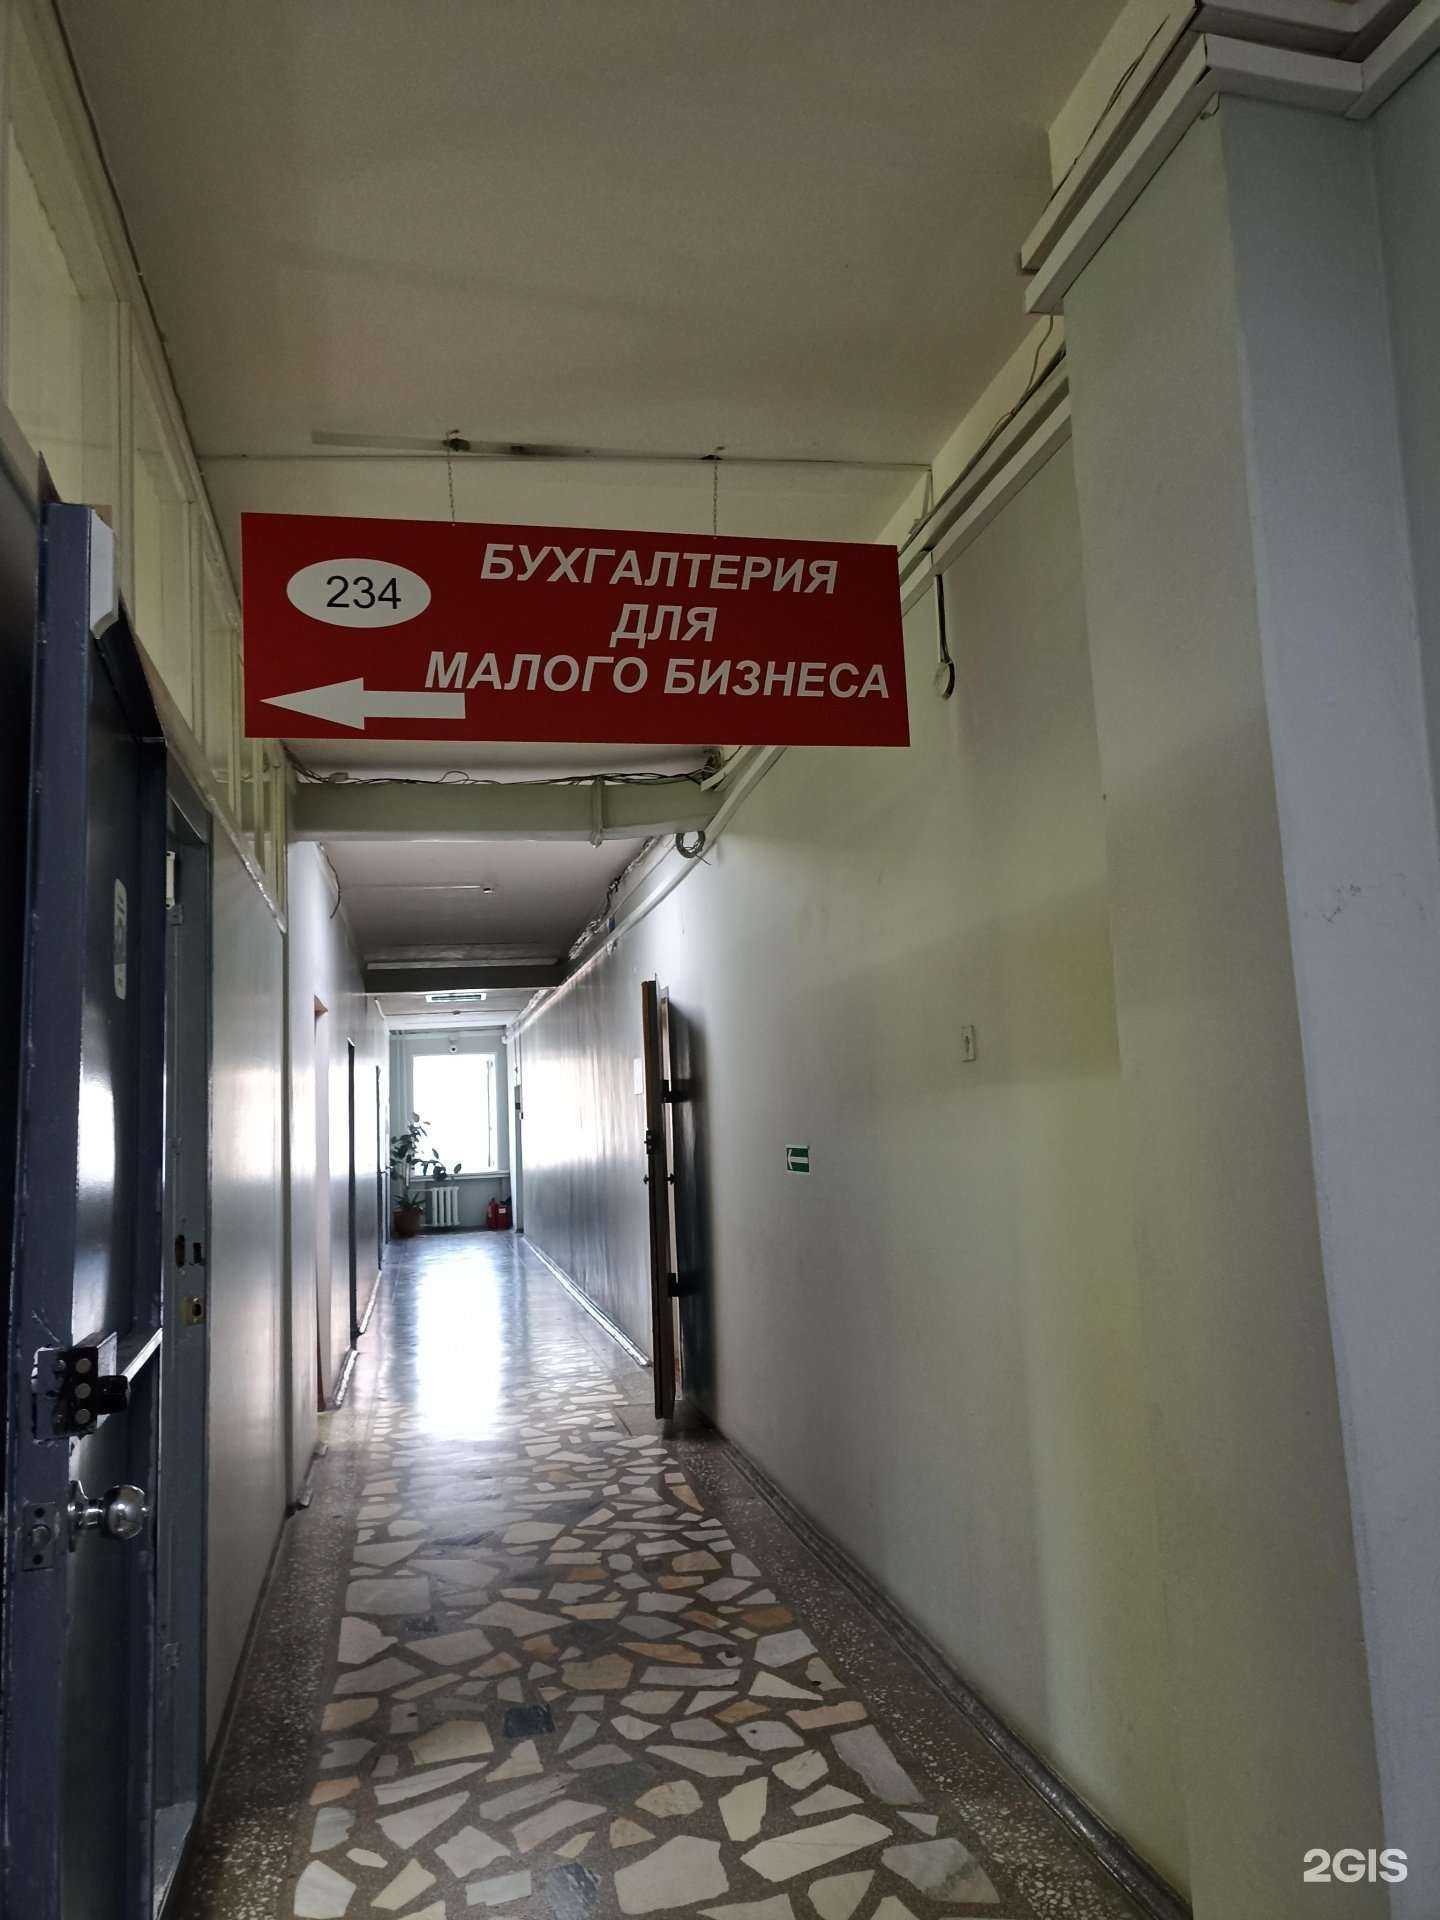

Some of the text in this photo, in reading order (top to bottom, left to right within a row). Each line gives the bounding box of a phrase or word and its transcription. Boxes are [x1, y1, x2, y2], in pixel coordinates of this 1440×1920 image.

[480, 543, 839, 594] БУХГАЛТЕРИЯ
[325, 575, 402, 610] 234
[609, 603, 717, 648] ДЛЯ
[424, 651, 890, 699] МАЛОГО БИЗНЕСА
